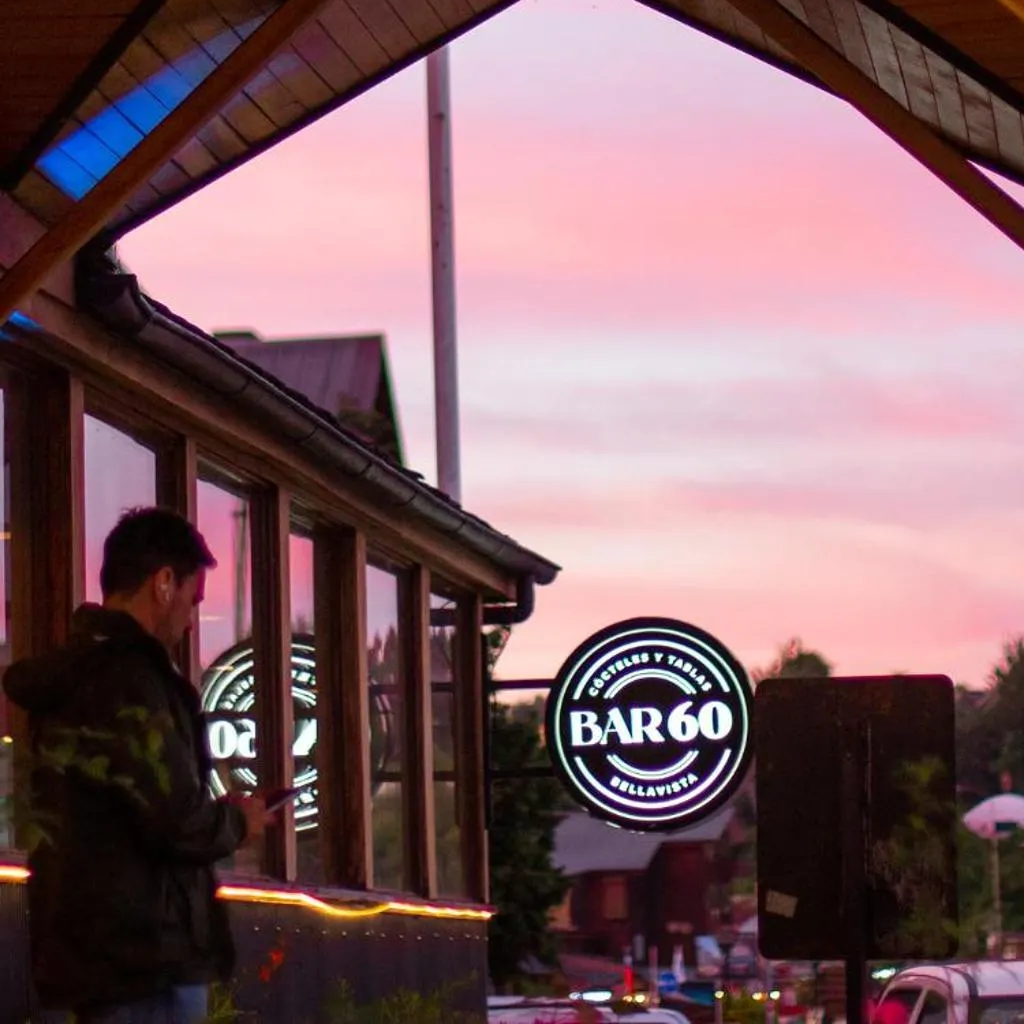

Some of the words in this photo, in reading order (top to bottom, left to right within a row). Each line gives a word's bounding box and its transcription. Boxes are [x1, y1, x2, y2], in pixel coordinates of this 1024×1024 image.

[653, 652, 663, 663] Y
[668, 654, 712, 692] TABLAS
[609, 772, 699, 797] BELLAVISTA
